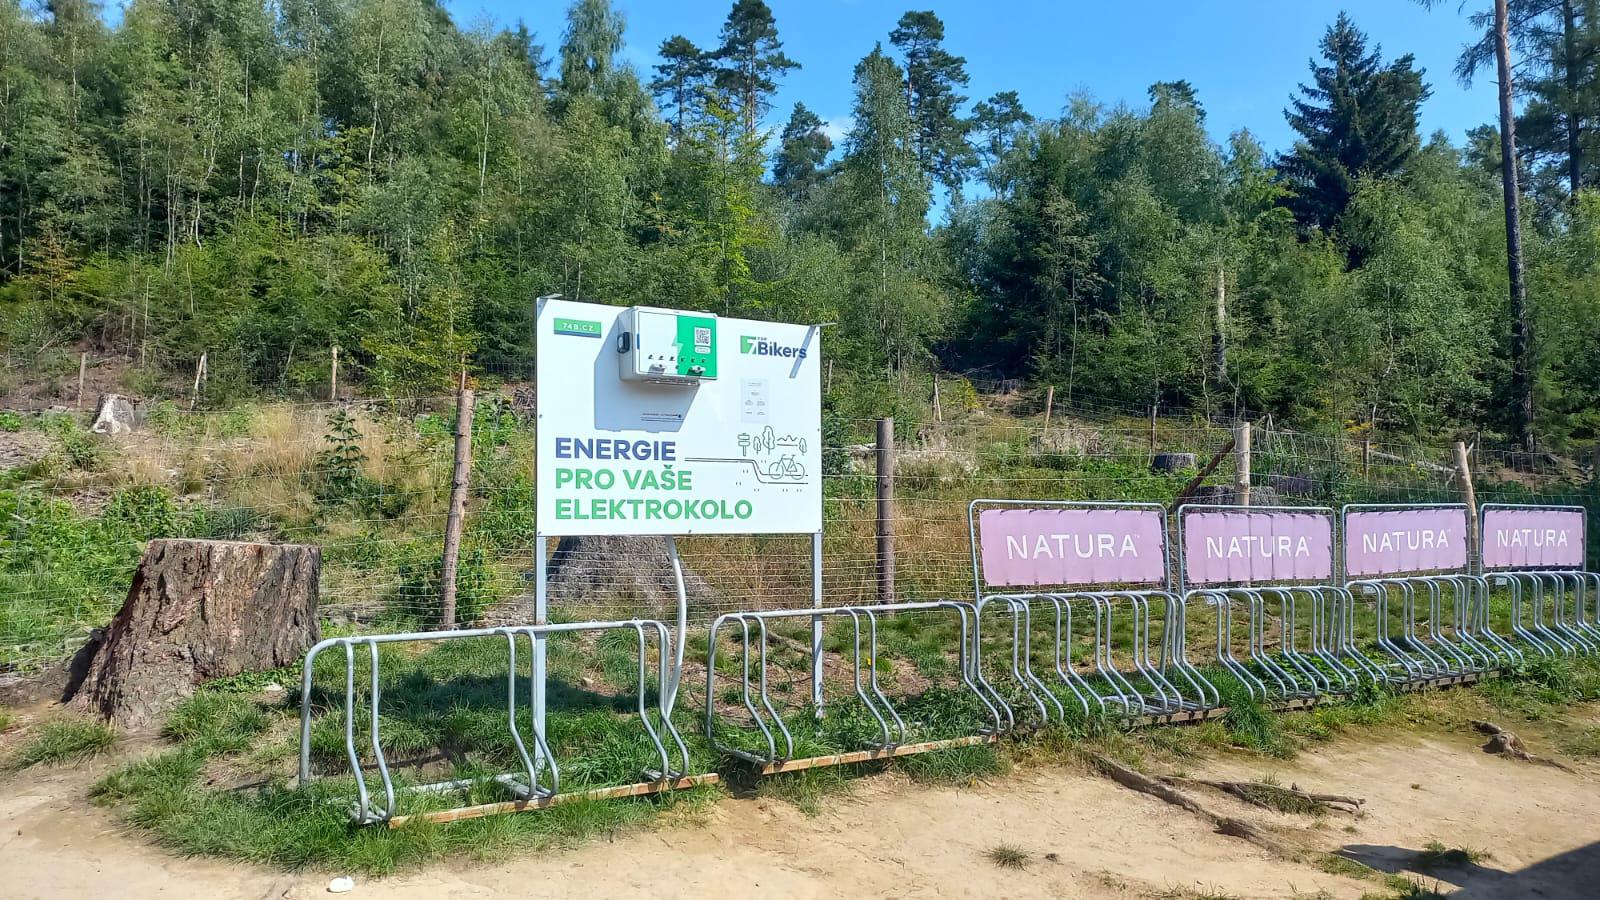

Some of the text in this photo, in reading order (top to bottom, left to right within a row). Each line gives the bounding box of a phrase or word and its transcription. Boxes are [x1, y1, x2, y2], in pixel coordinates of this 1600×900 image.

[757, 341, 807, 358] Bikers
[555, 437, 676, 461] ENERGIE
[555, 464, 692, 490] PRO VAŠE
[555, 499, 753, 520] ELEKTROKOLO
